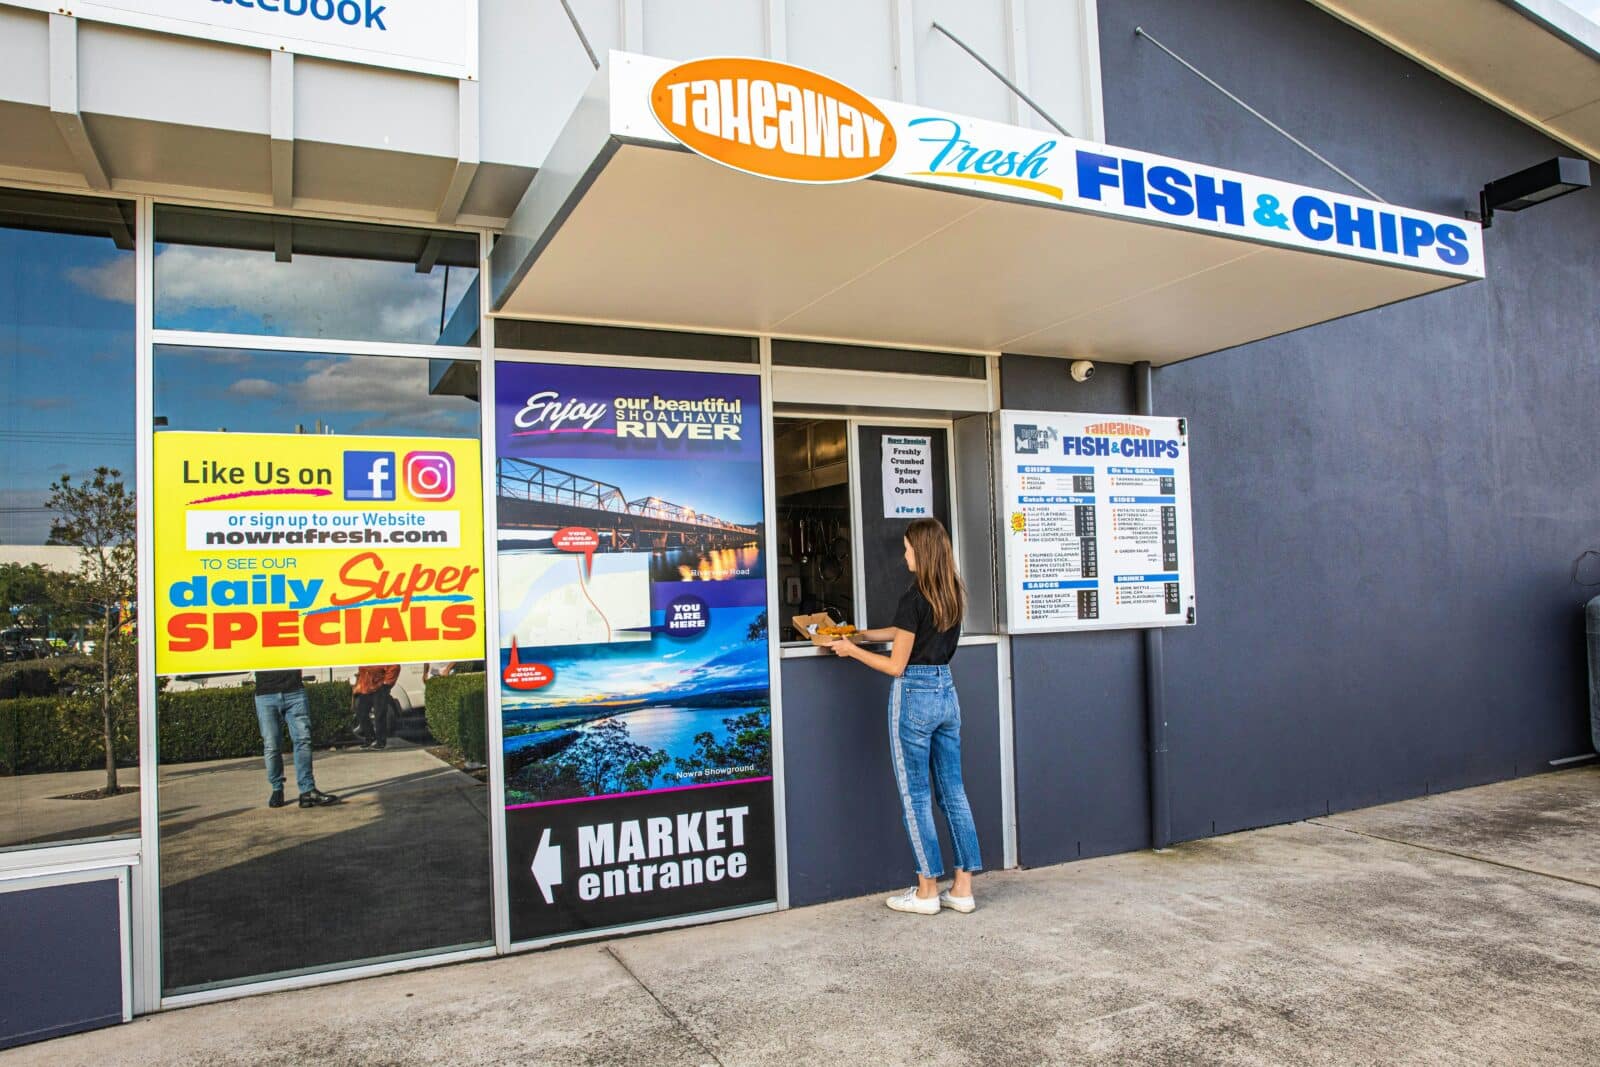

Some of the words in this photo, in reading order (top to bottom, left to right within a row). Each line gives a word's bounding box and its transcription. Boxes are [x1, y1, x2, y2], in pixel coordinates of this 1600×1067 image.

[908, 117, 1057, 180] Fresh
[1075, 150, 1245, 227] FISH
[1253, 194, 1291, 231] &
[1292, 196, 1470, 265] CHIPS
[514, 391, 607, 430] Enjoy
[614, 397, 649, 411] our
[653, 396, 741, 414] beautiful
[615, 410, 743, 424] SHOALHAVEN
[616, 421, 743, 441] RIVER
[893, 447, 922, 456] Freshly
[1063, 436, 1110, 456] FISH
[1111, 441, 1121, 454] &
[1121, 438, 1180, 459] CHIPS
[890, 457, 925, 465] Crumbed
[183, 460, 245, 485] Like
[255, 461, 290, 485] Us
[299, 468, 332, 485] on
[894, 467, 921, 476] Sydney
[894, 487, 923, 495] Oysters
[228, 514, 246, 527] or
[250, 512, 290, 530] sign
[291, 515, 309, 530] up
[312, 513, 328, 527] to
[332, 515, 360, 527] our
[362, 512, 426, 527] Website
[206, 528, 448, 545] nowrafresh.com
[200, 558, 222, 570] TO
[226, 558, 257, 570] SEE
[262, 557, 297, 569] OUR
[169, 574, 324, 610] daily
[330, 552, 480, 613] Super
[673, 603, 701, 612] YOU
[669, 620, 706, 629] HERE
[673, 612, 701, 621] ARE
[167, 604, 477, 653] SPECIALS
[676, 770, 703, 779] Nowra
[704, 764, 755, 776] Showground
[577, 806, 750, 869] MARKET
[577, 852, 748, 901] entrance
